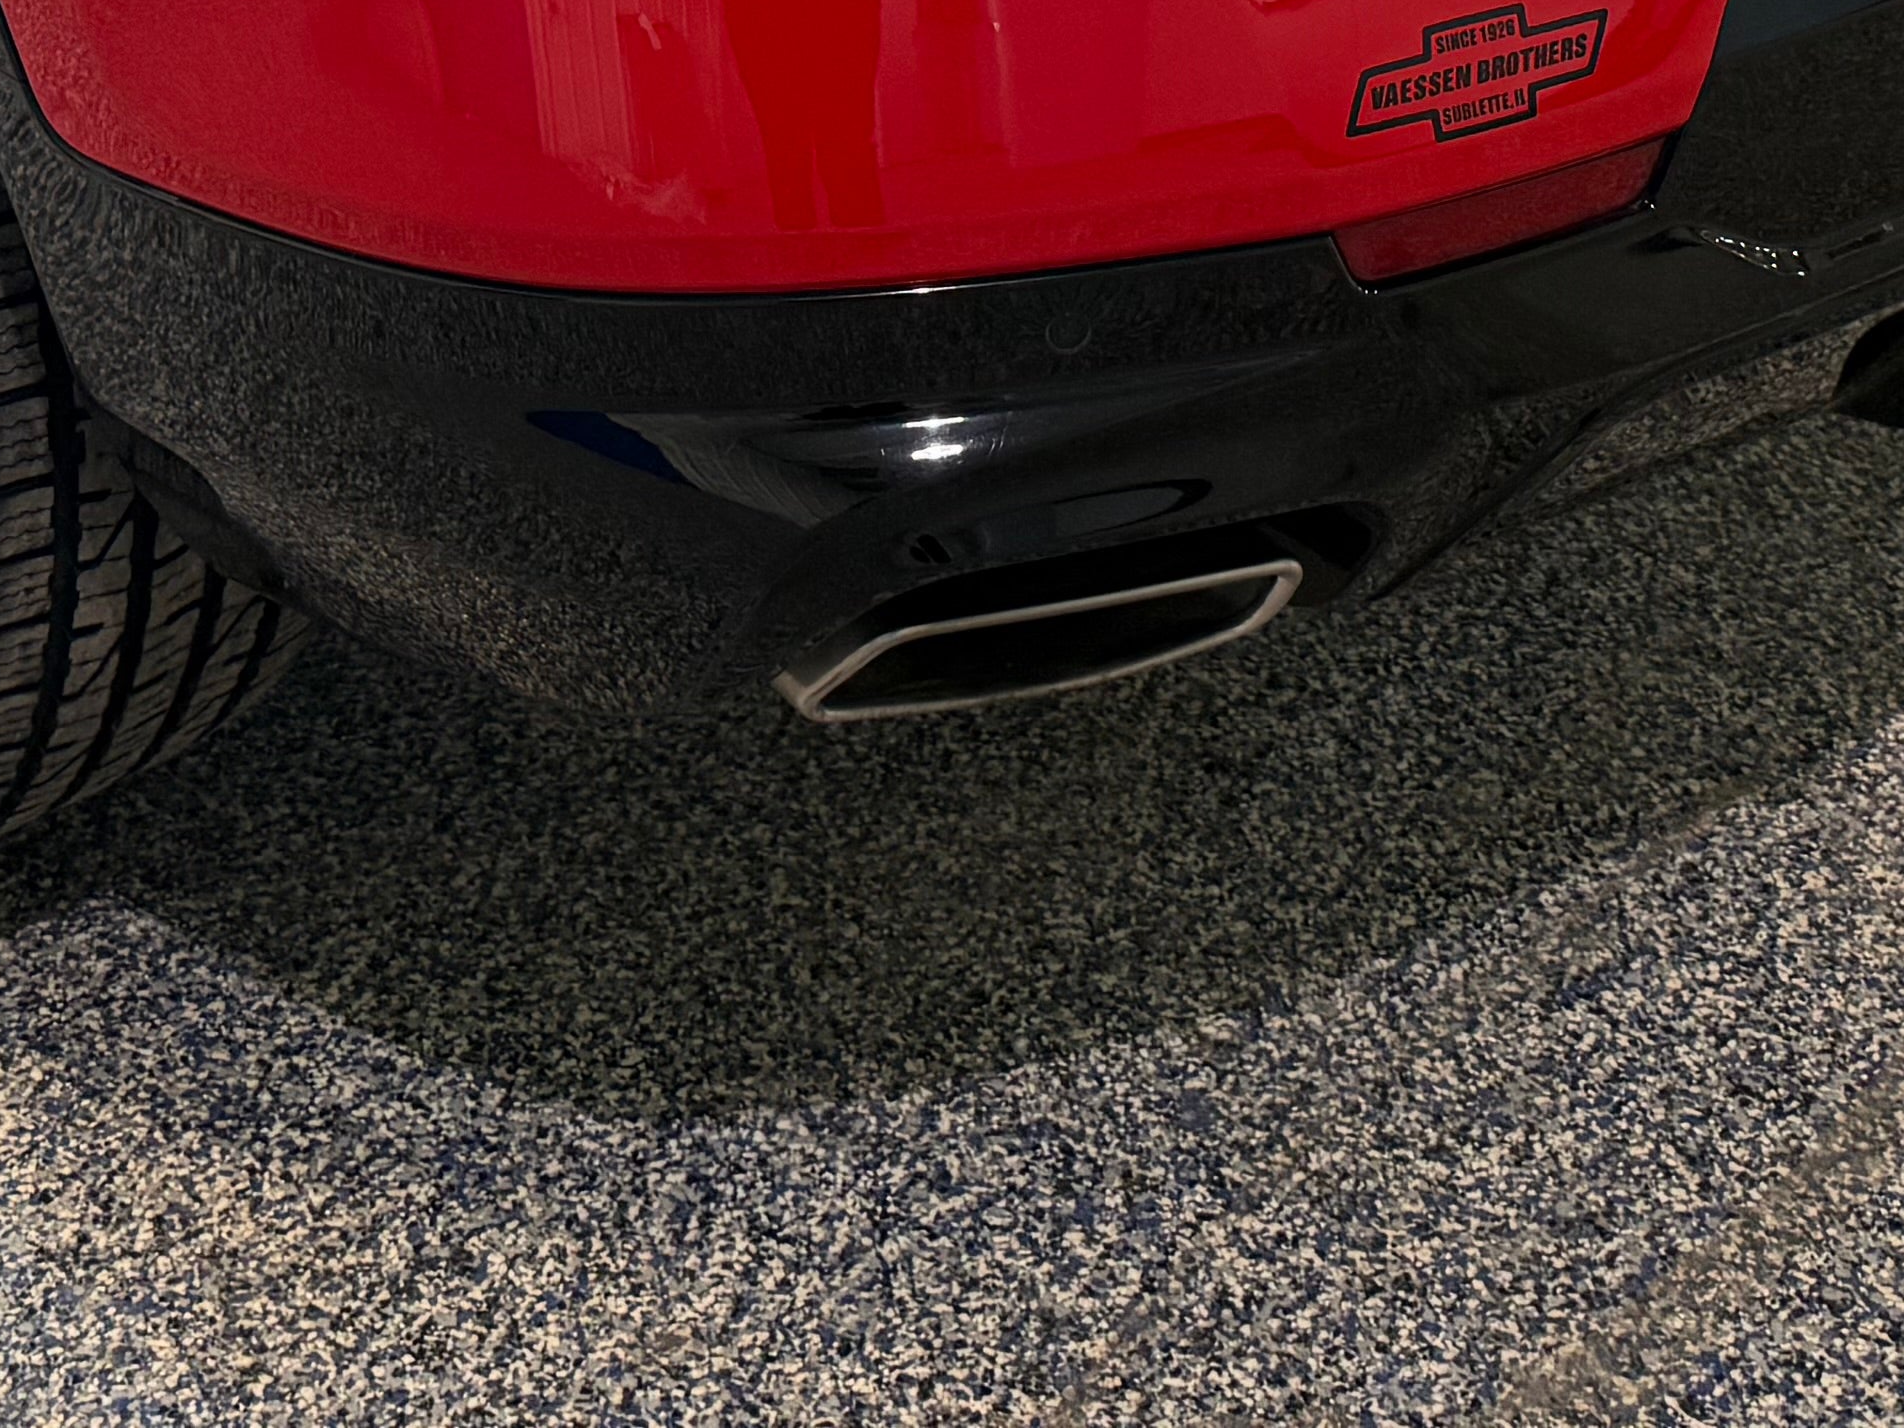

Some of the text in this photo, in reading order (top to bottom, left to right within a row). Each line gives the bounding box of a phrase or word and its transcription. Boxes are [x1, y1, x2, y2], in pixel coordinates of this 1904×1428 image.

[1435, 18, 1515, 54] SINCE 1926
[1370, 33, 1588, 110] VAESSEN BROTHERS
